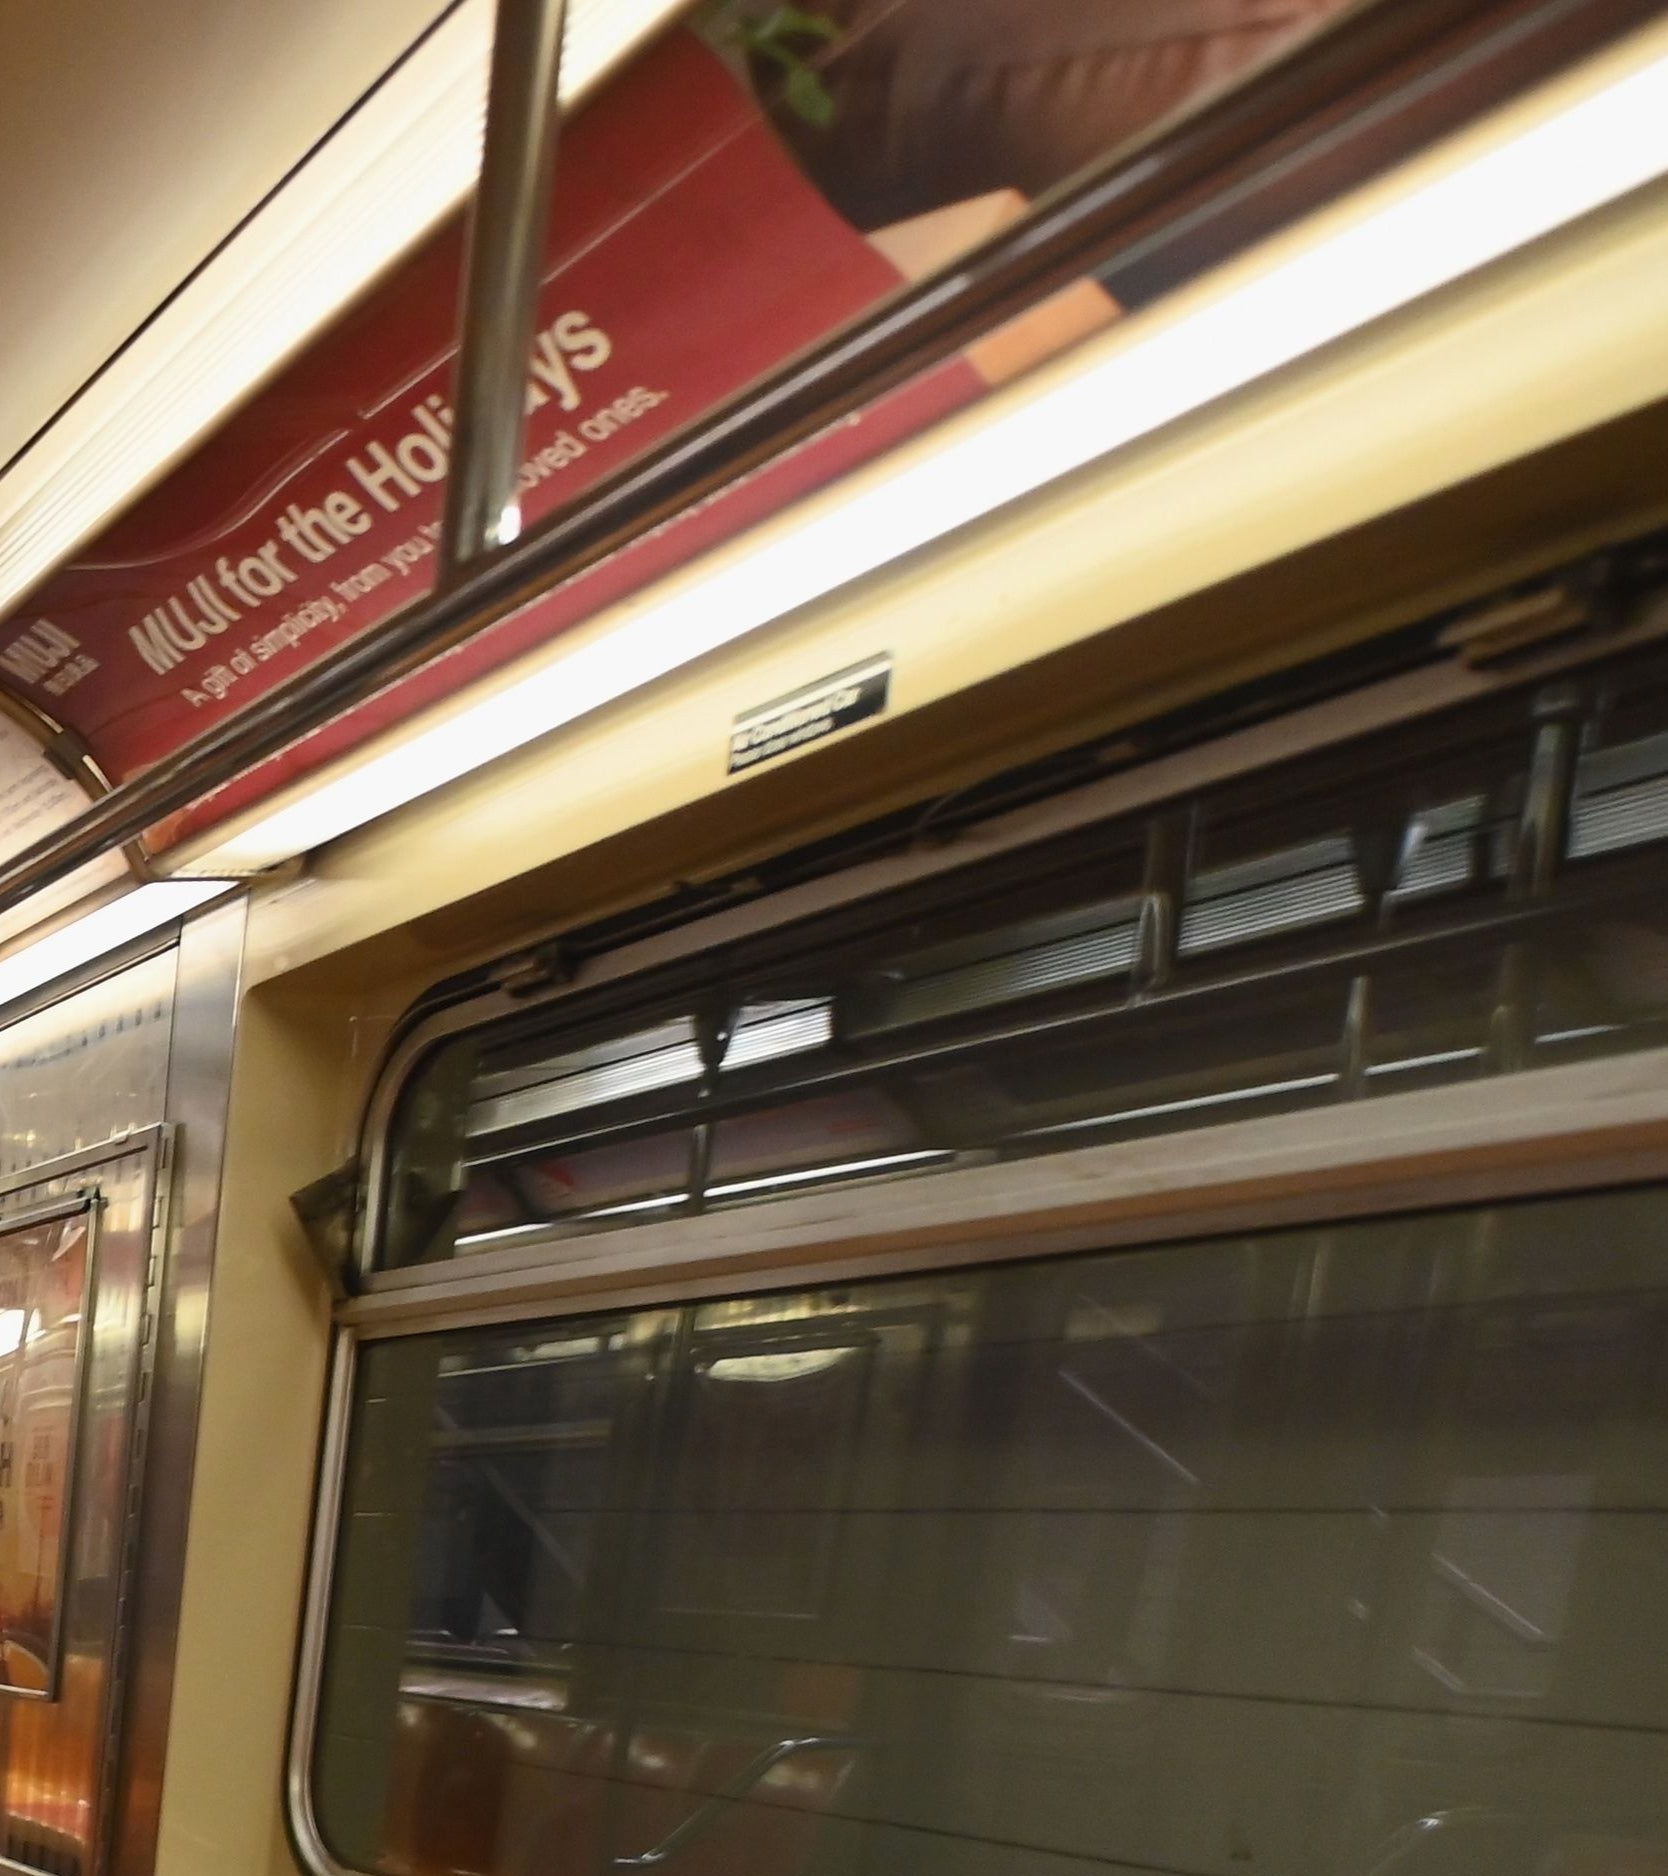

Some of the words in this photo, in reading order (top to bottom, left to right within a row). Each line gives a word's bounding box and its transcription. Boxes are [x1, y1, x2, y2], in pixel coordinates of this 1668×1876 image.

[128, 574, 242, 677] MUJI
[217, 540, 299, 609] for
[276, 489, 374, 565] the
[346, 310, 613, 514] Holiys
[181, 687, 210, 708] A
[250, 594, 348, 663] simplicity,
[382, 536, 433, 577] you
[515, 430, 587, 488] oved
[578, 385, 670, 441] ones.
